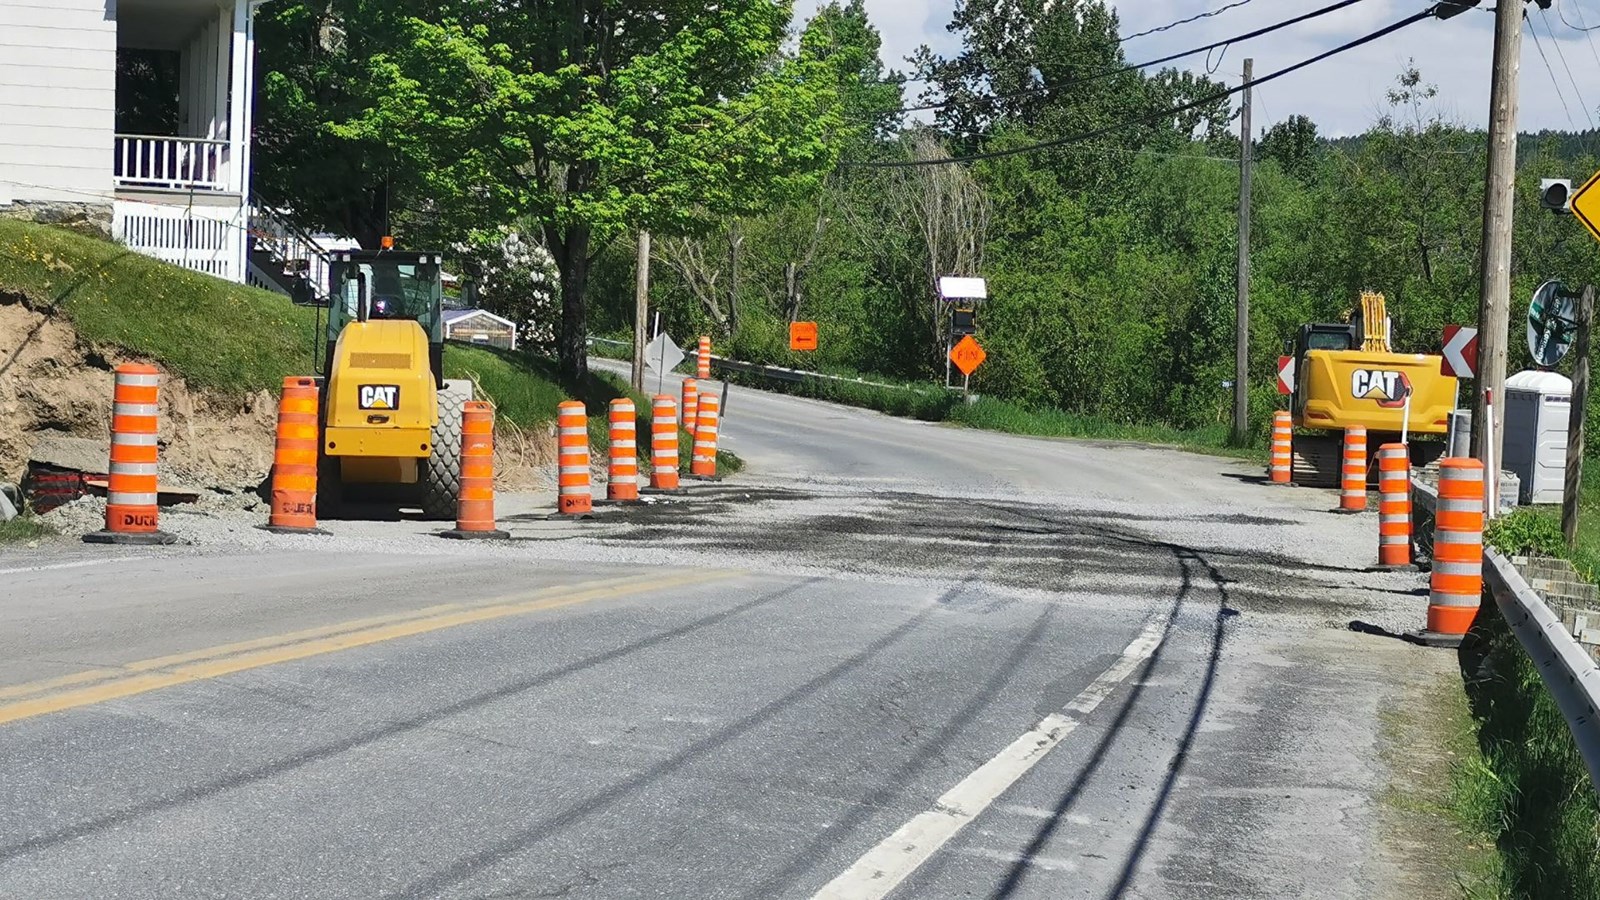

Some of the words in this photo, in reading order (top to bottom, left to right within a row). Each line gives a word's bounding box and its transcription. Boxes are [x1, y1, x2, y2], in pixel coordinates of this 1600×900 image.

[957, 350, 978, 361] FIN
[1352, 369, 1399, 399] CAT
[361, 386, 397, 408] CAT
